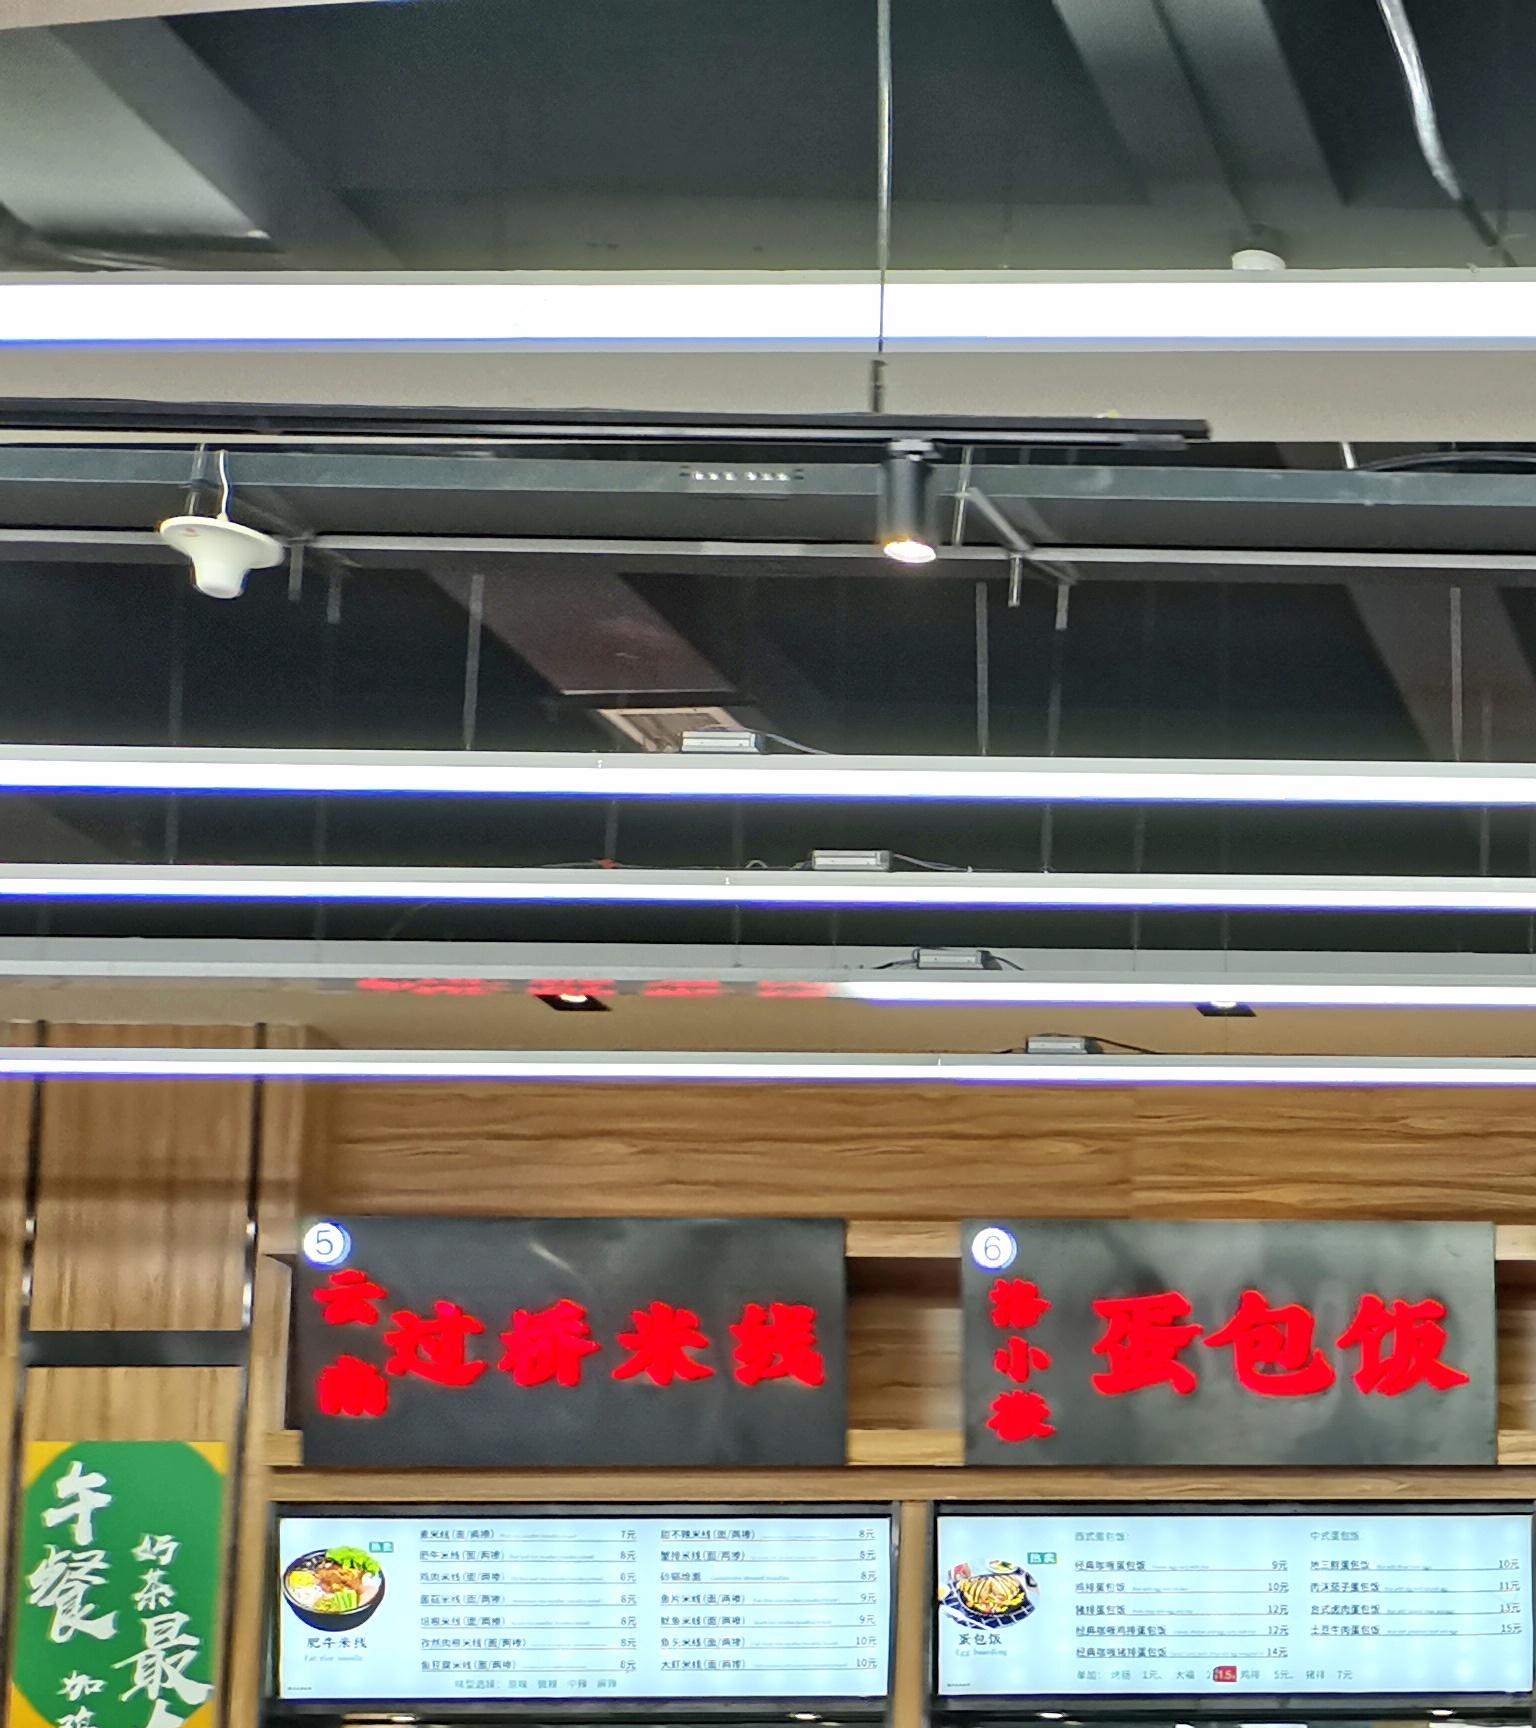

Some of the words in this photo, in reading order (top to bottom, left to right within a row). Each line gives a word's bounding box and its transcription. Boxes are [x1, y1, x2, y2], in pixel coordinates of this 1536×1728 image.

[315, 1229, 334, 1256] 5
[984, 1235, 1002, 1261] 6
[383, 1300, 827, 1389] 过桥米线
[1092, 1290, 1470, 1397] 蛋包饭
[958, 1633, 1002, 1646] 蛋包饭
